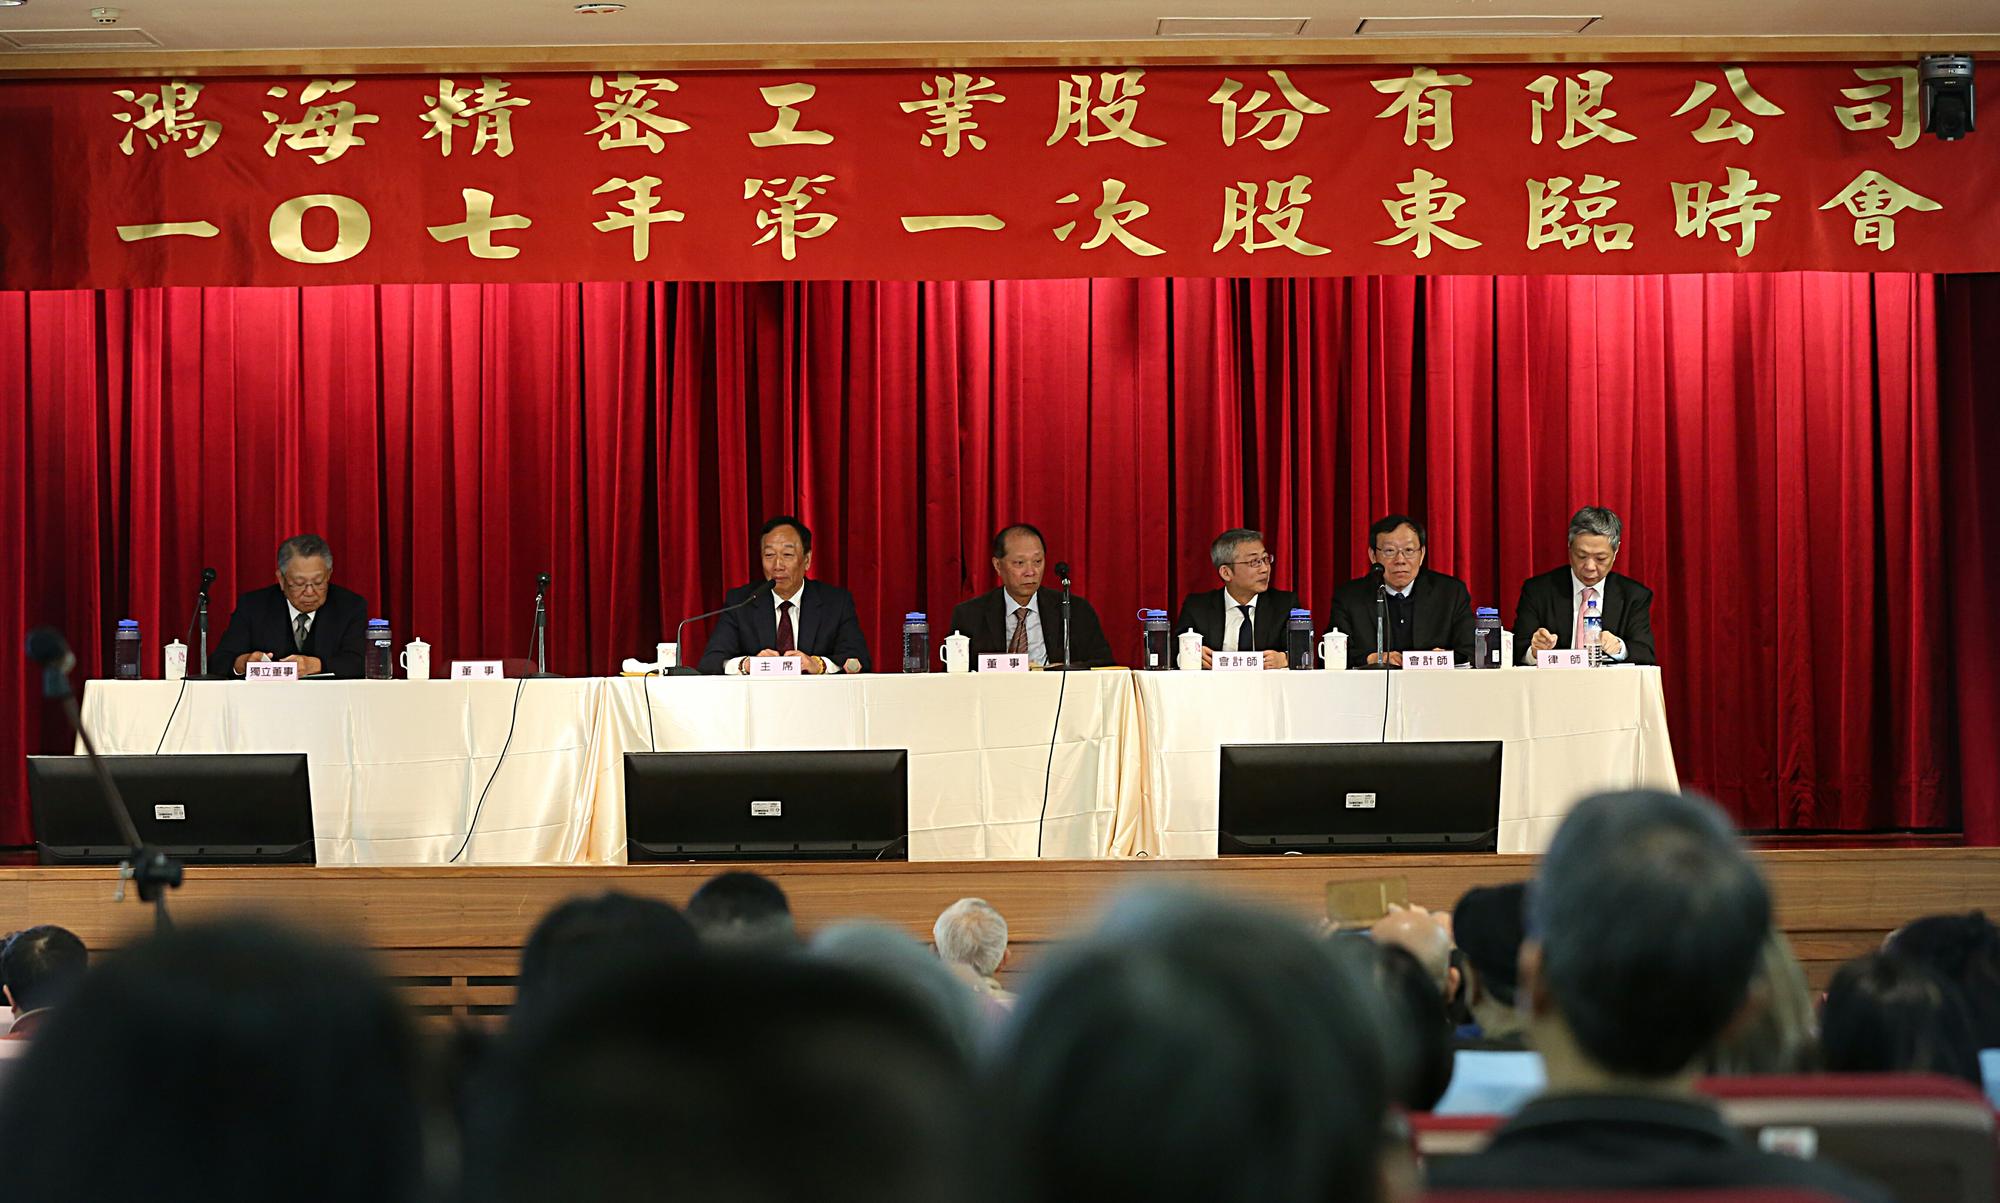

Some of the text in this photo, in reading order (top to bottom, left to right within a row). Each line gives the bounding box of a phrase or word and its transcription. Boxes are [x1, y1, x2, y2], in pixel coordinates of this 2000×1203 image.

[113, 66, 1920, 165] 鴻海精密工業股份有限公司
[987, 658, 1020, 669] 董事
[1219, 656, 1258, 667] 會計師
[1409, 655, 1448, 666] 會計師
[1548, 654, 1581, 665] 律師
[250, 666, 294, 677] 獨立董事
[462, 665, 494, 676] 董事
[760, 661, 793, 671] 主席
